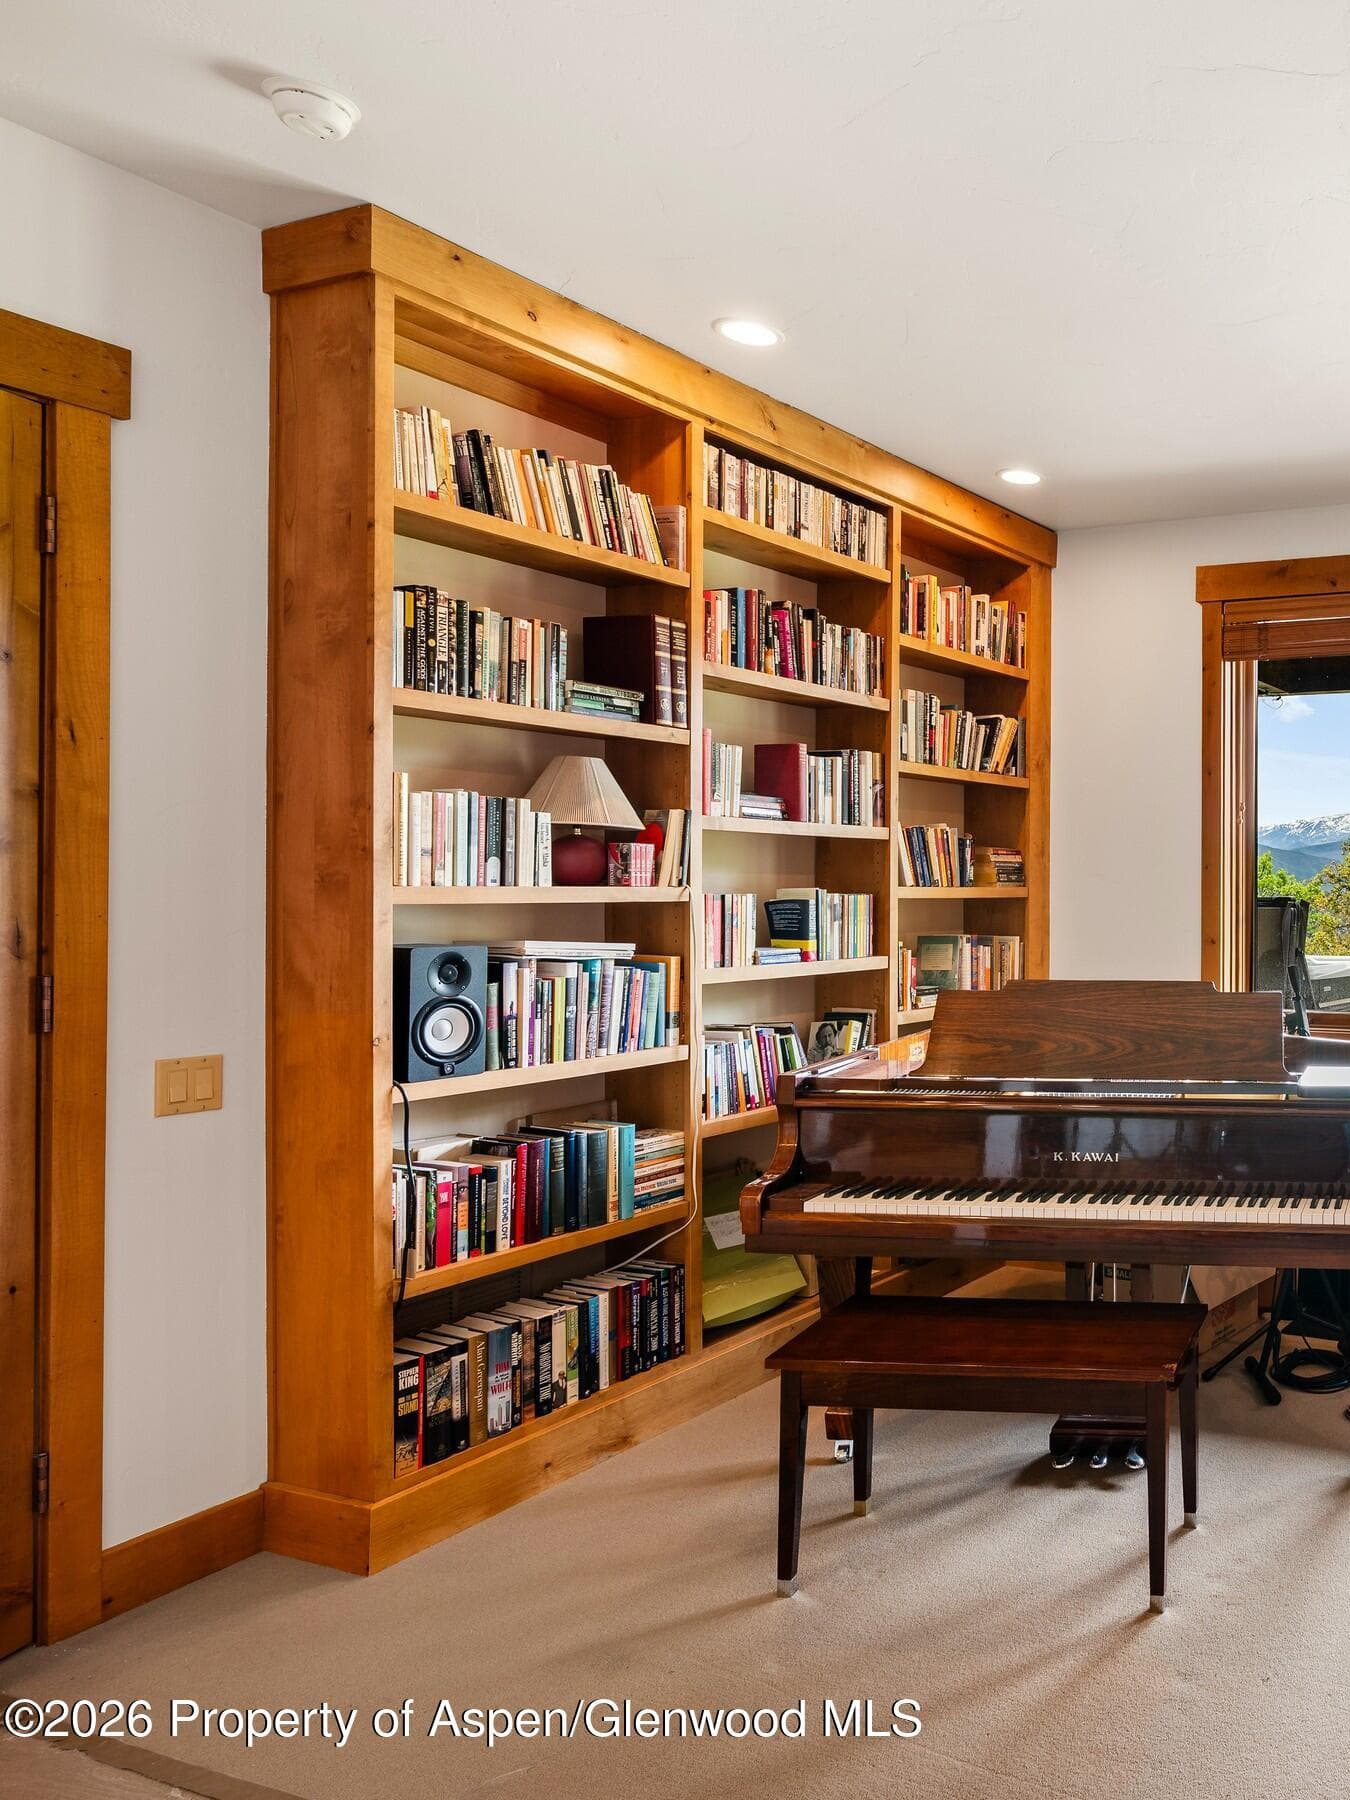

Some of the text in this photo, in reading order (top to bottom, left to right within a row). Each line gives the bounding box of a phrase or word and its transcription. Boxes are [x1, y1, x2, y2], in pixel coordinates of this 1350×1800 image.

[438, 610, 448, 657] TRIANGLE
[1053, 1151, 1119, 1162] K. KAWAI
[398, 1366, 419, 1379] STEPHEN
[473, 1341, 486, 1412] Alan Greenspan
[539, 1352, 551, 1384] ORDINARY
[398, 1374, 419, 1391] KING
[398, 1399, 419, 1416] STAND
